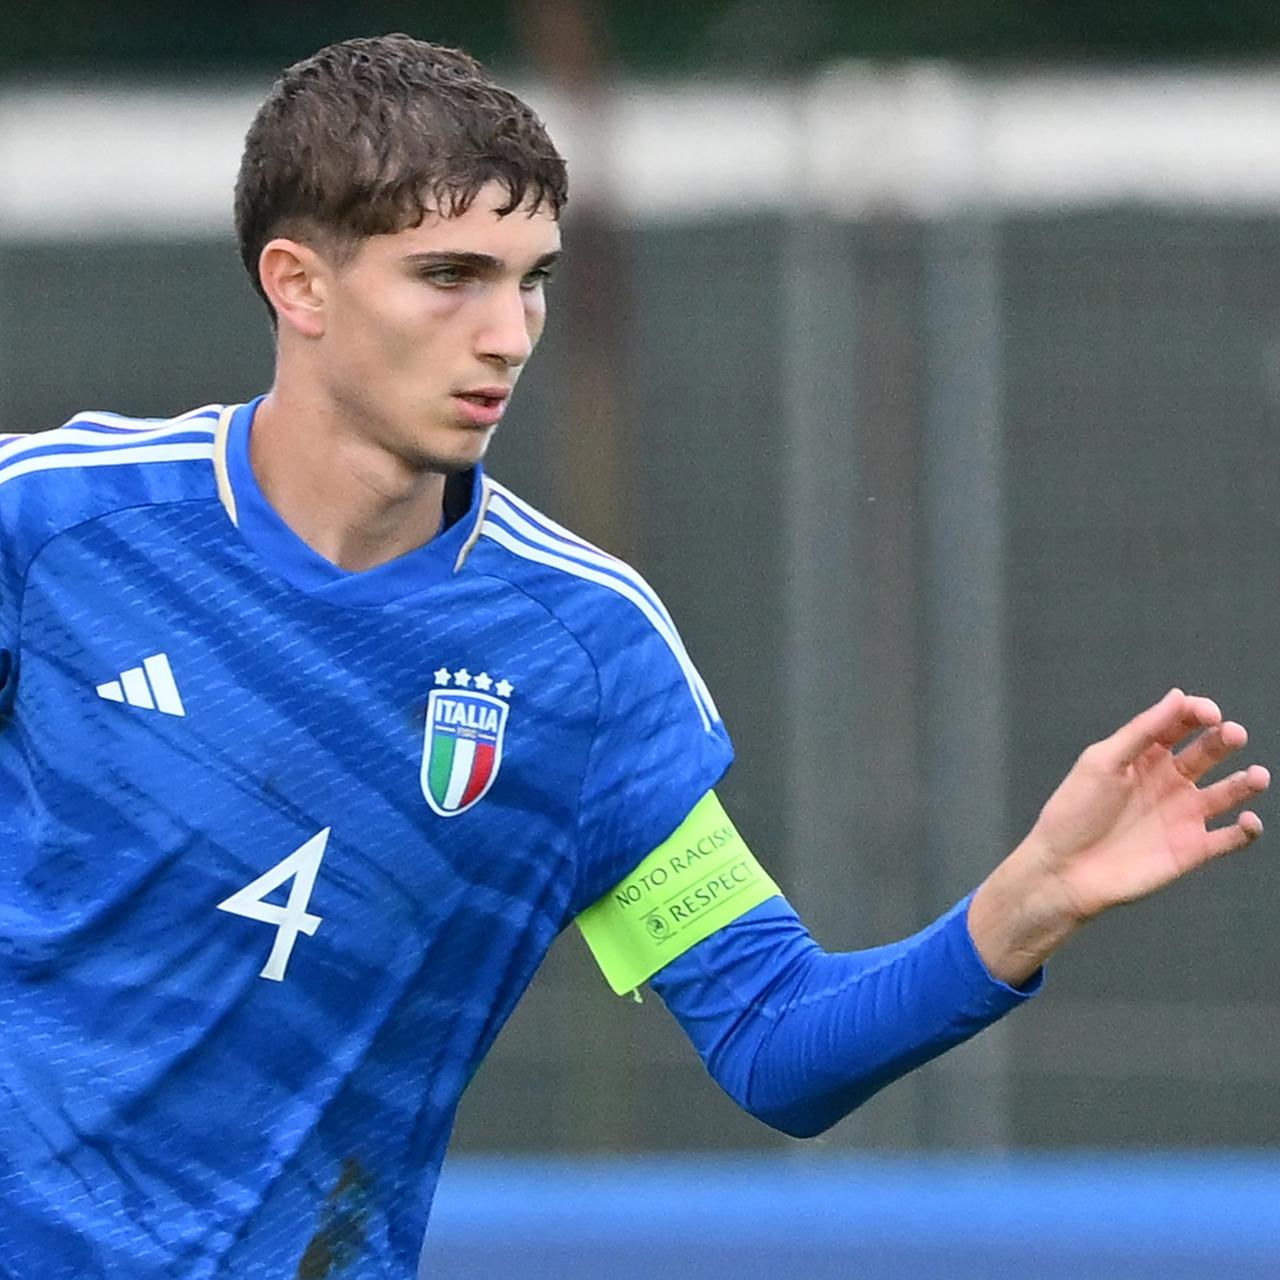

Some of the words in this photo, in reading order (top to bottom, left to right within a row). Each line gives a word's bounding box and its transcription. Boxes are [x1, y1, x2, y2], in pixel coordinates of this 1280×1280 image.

[434, 698, 498, 733] ITALIA
[215, 825, 332, 982] 4
[614, 884, 642, 910] NO
[639, 867, 668, 892] TO
[668, 861, 755, 922] RESPECT
